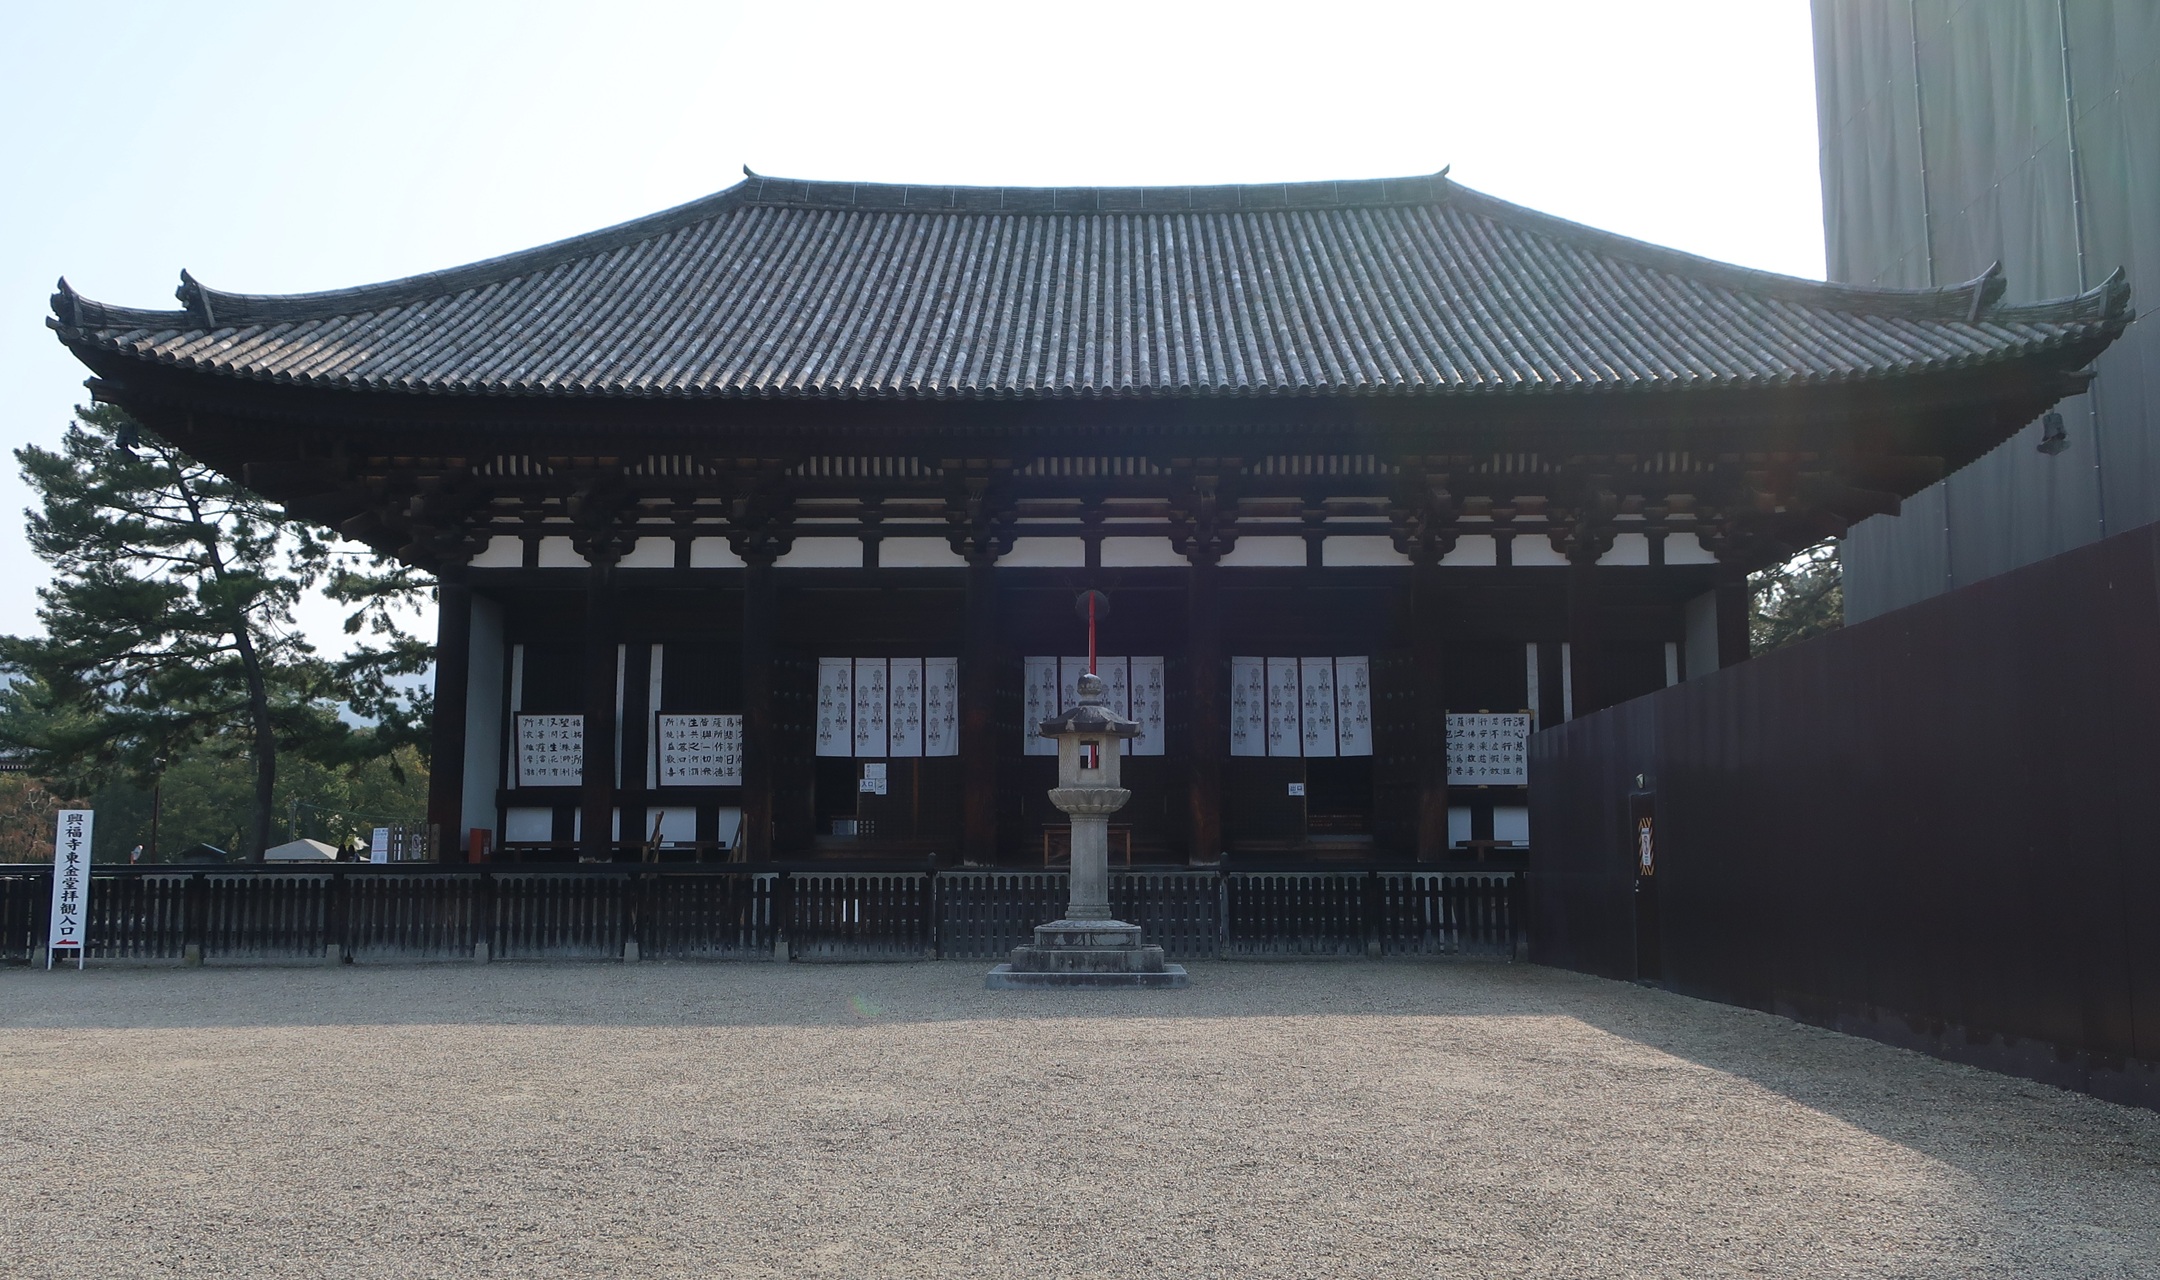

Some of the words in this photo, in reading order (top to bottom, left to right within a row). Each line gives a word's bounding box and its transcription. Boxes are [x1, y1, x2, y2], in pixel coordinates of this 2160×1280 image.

[59, 813, 83, 935] 興福寺東金堂拝観入口
